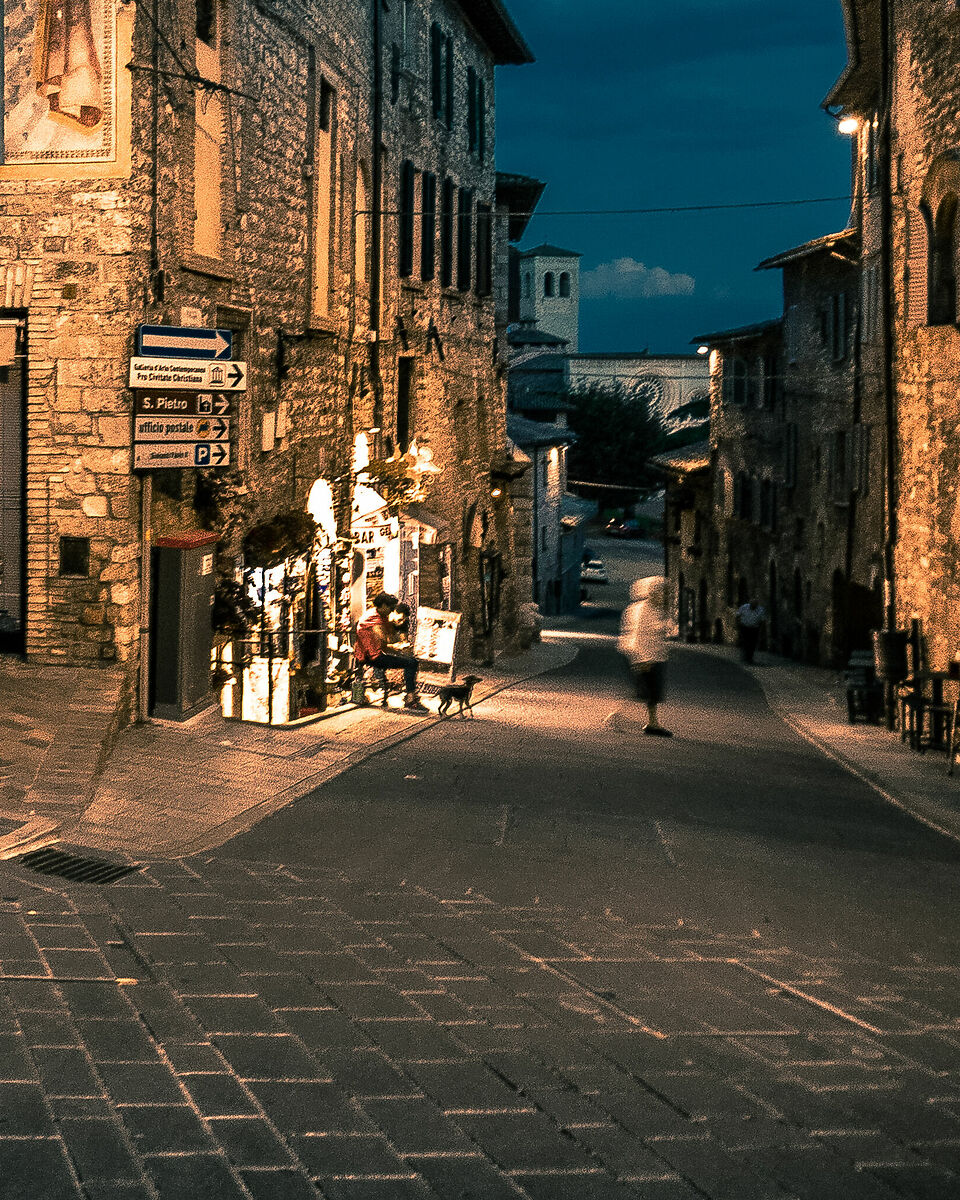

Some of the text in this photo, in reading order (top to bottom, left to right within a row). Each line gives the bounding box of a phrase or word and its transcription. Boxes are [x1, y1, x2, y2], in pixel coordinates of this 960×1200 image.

[137, 373, 147, 381] Pro
[143, 397, 188, 409] S. Pietro
[139, 421, 193, 435] ufficio postale
[198, 447, 208, 462] P
[353, 531, 375, 544] BAR
